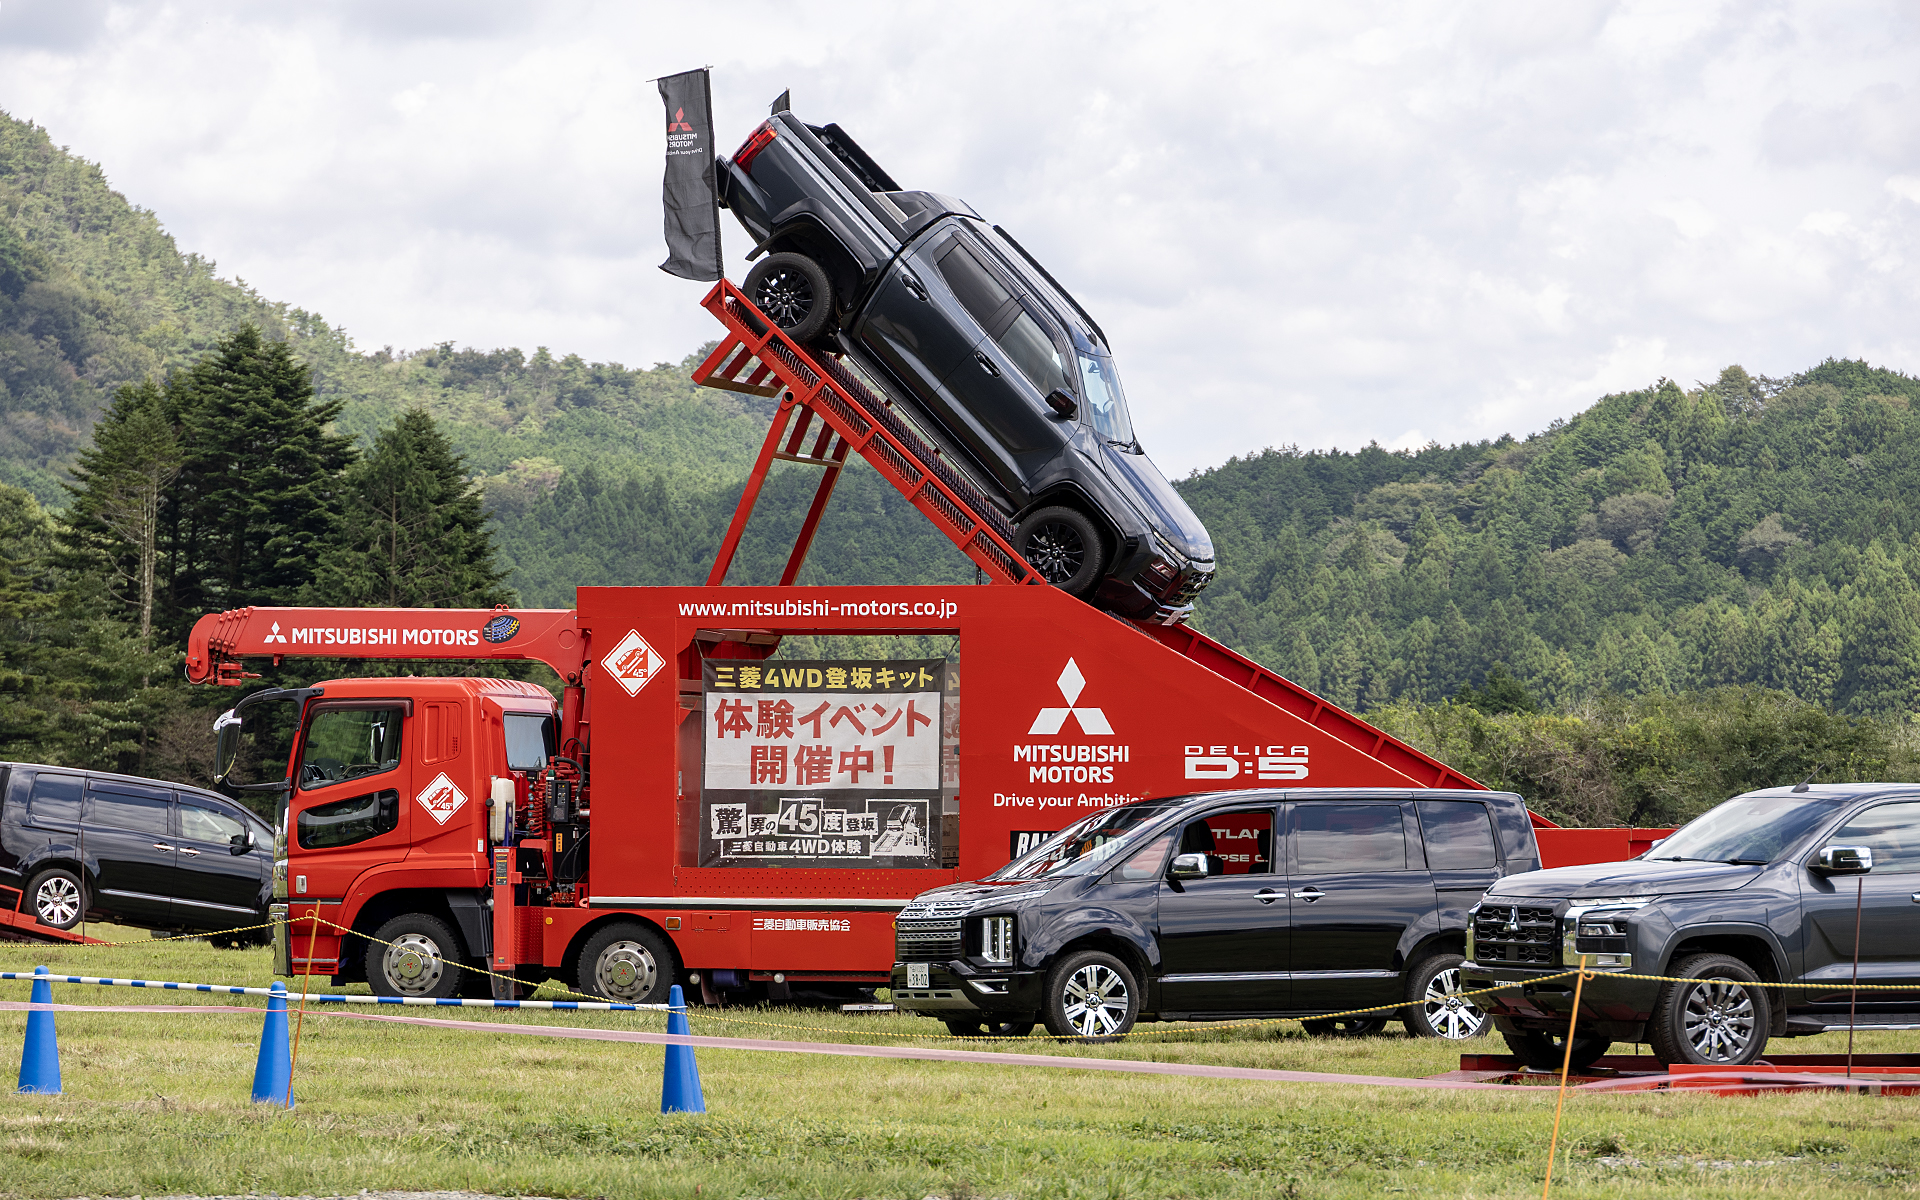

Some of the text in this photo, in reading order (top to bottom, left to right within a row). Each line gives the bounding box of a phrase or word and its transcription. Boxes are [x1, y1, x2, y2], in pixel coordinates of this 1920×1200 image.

[678, 598, 958, 619] www.mitsubishi-motors.co.jp
[291, 628, 480, 646] MITSUBISHI MOTORS
[714, 666, 934, 690] 三菱4WD登坂キット
[713, 698, 932, 739] 体験イベント
[1013, 744, 1130, 763] MITSUBISHI
[1184, 745, 1309, 756] DELICA
[1029, 765, 1114, 784] MOTORS
[1184, 756, 1309, 780] D:5
[993, 793, 1145, 811] Drive your Ambiti
[731, 838, 862, 855] 三菱自動車4WD体験
[752, 918, 851, 932] 三菱自動車販売協会
